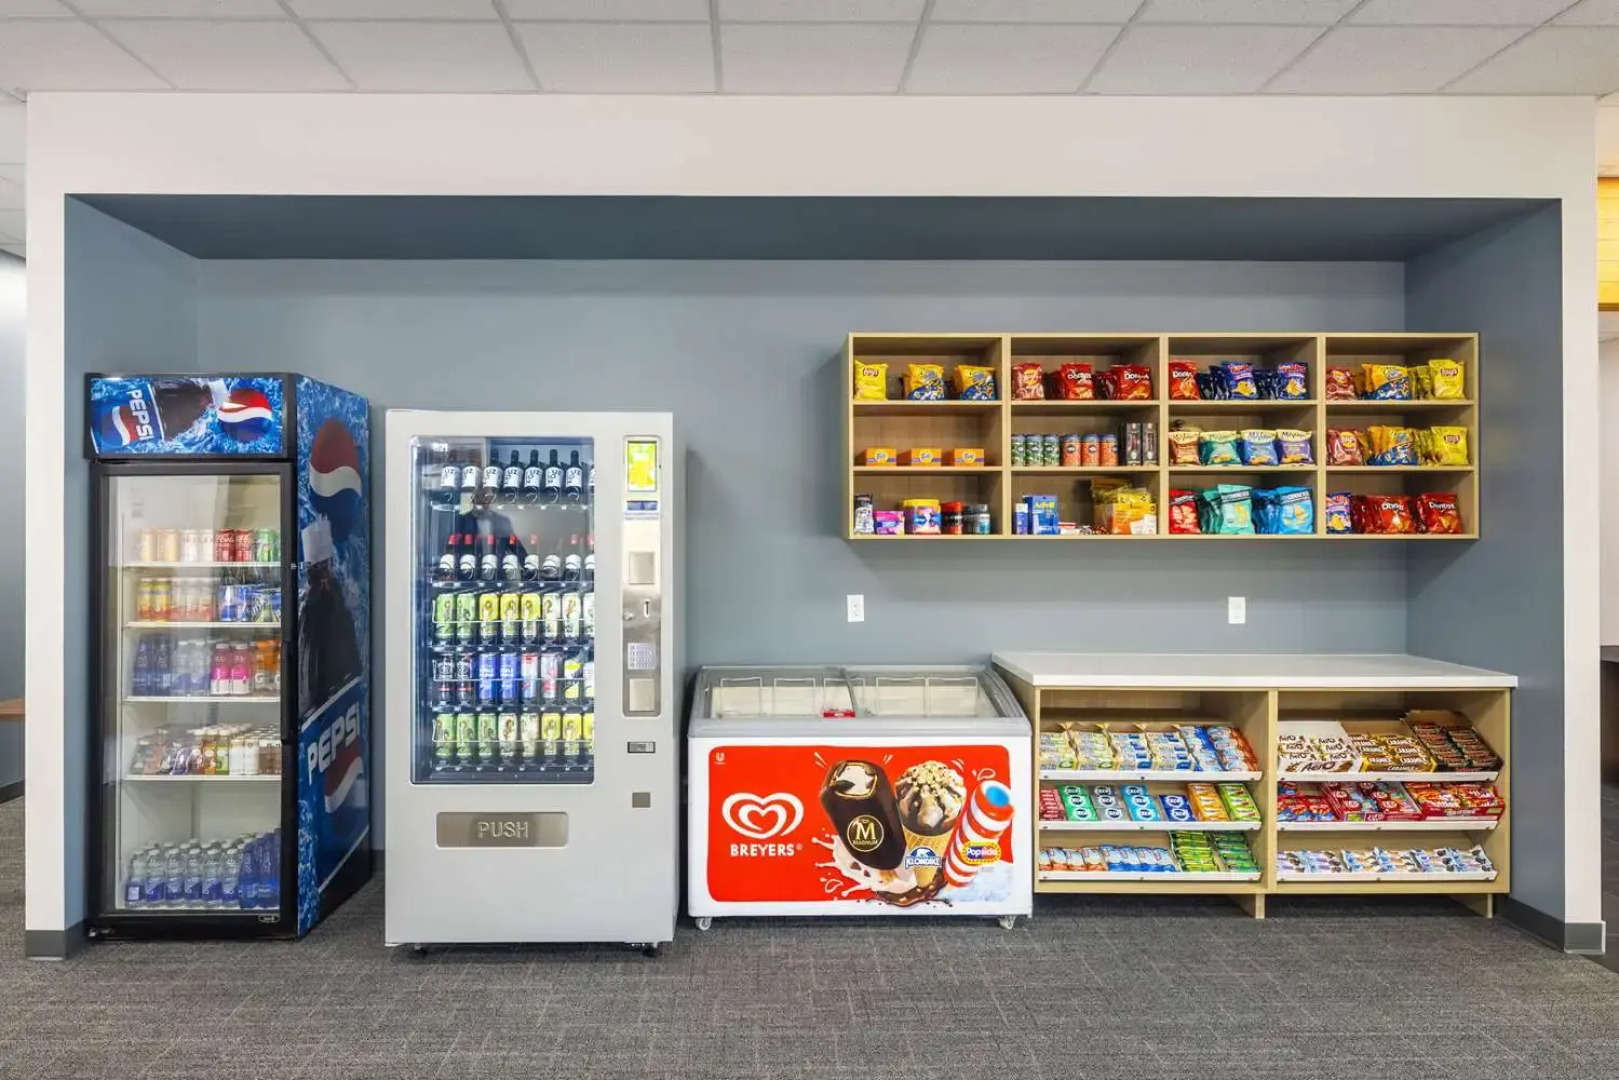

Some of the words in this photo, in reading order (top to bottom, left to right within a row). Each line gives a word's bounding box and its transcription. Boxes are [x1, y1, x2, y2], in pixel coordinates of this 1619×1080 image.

[126, 389, 153, 441] PEPSI
[1034, 500, 1055, 509] Advil
[307, 703, 360, 786] PEPSI
[477, 821, 529, 839] PUSH
[855, 822, 876, 840] M
[729, 843, 795, 857] BREYERS
[905, 857, 942, 869] KLONDIKE
